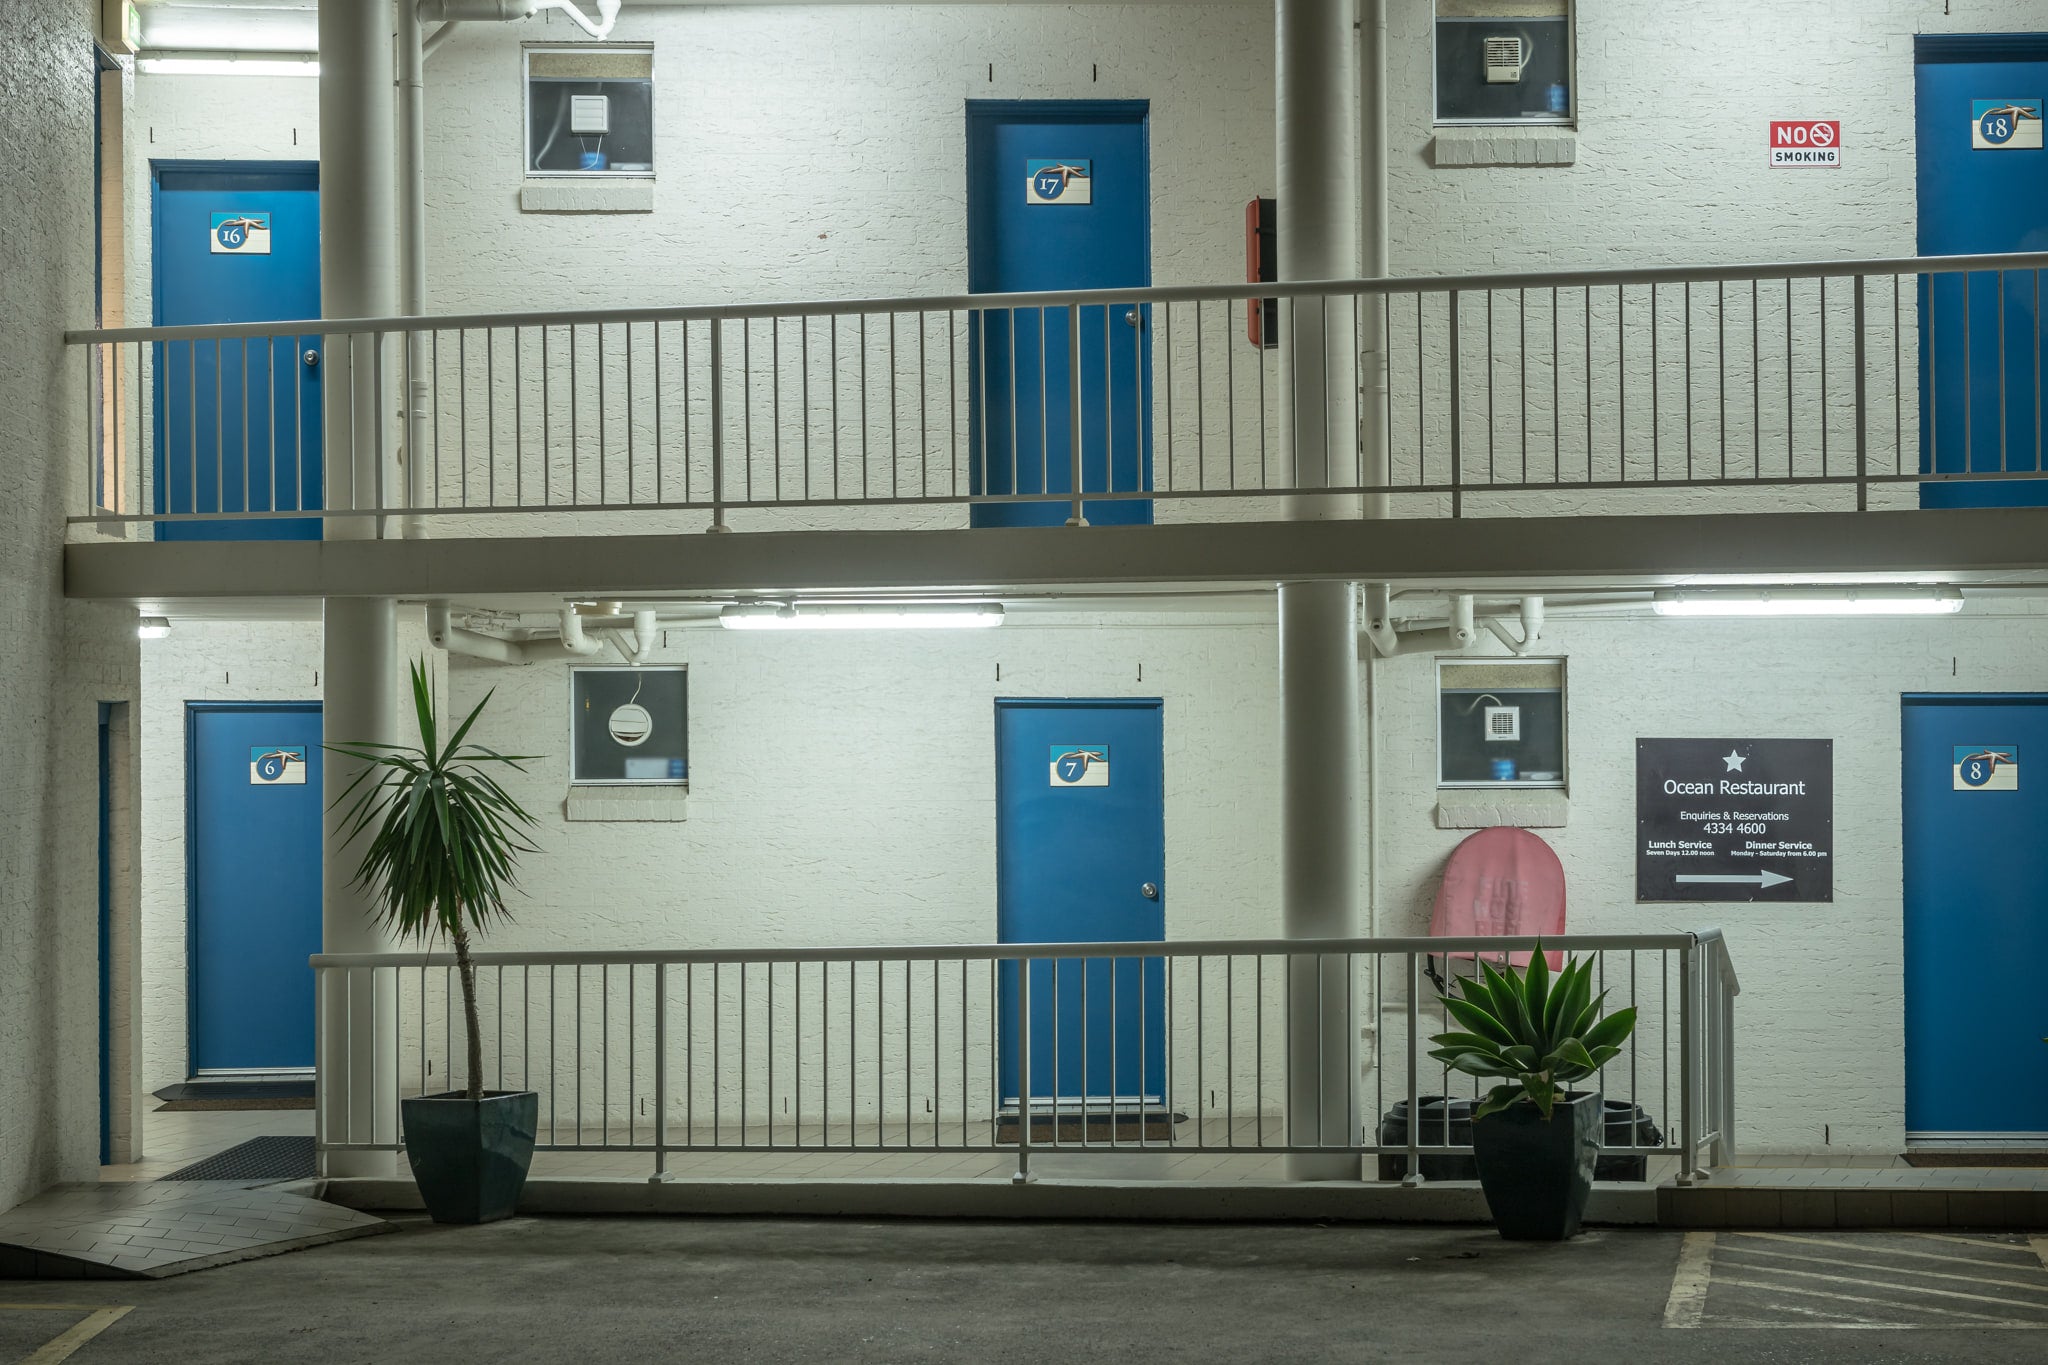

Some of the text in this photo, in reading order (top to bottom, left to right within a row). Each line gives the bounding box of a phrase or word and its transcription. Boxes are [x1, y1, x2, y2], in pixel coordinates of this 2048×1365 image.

[1777, 126, 1807, 145] NO
[1986, 118, 2008, 138] 18
[1775, 152, 1835, 162] SMOKING
[1039, 178, 1059, 195] 17
[222, 228, 241, 244] 16
[265, 760, 275, 775] 6
[1065, 762, 1077, 777] 7
[1970, 762, 1982, 780] 8
[1663, 779, 1806, 795] Ocean Restaurant
[1680, 811, 1790, 822] Enquiries & Reservations
[1703, 822, 1766, 834] 4334 4600
[1648, 840, 1712, 849] Lunch Service
[1745, 841, 1813, 850] Dinner Service
[1665, 849, 1680, 857] Days
[1730, 850, 1754, 858] Monday
[1759, 850, 1787, 858] Saturday
